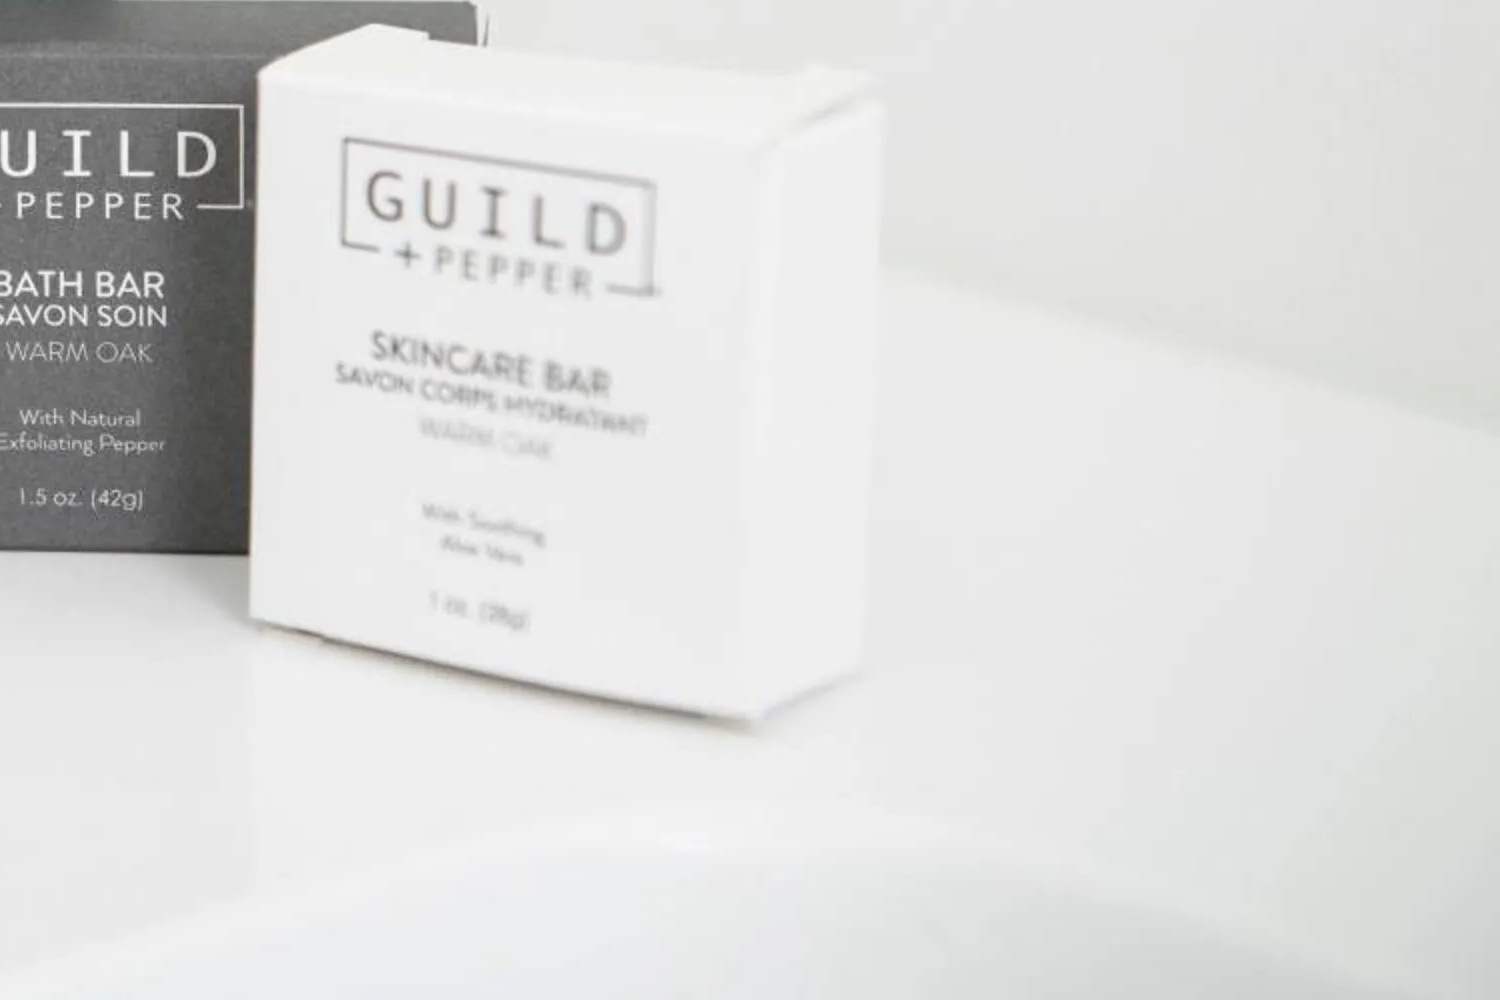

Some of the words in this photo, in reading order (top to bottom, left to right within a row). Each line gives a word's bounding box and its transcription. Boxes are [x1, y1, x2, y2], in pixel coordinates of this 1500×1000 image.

[366, 169, 627, 257] GUILD
[95, 271, 165, 299] BAR
[97, 304, 168, 327] SOIN
[6, 341, 89, 362] WARM
[96, 341, 155, 364] OAK
[371, 329, 534, 388] SKINCARE
[541, 358, 613, 400] BAR
[335, 361, 414, 395] SAVON
[418, 377, 499, 413] CORPS
[19, 408, 64, 426] With
[70, 407, 142, 427] Natural
[99, 433, 167, 456] Pepper
[19, 487, 47, 506] 1.5
[90, 487, 144, 514] (42g)
